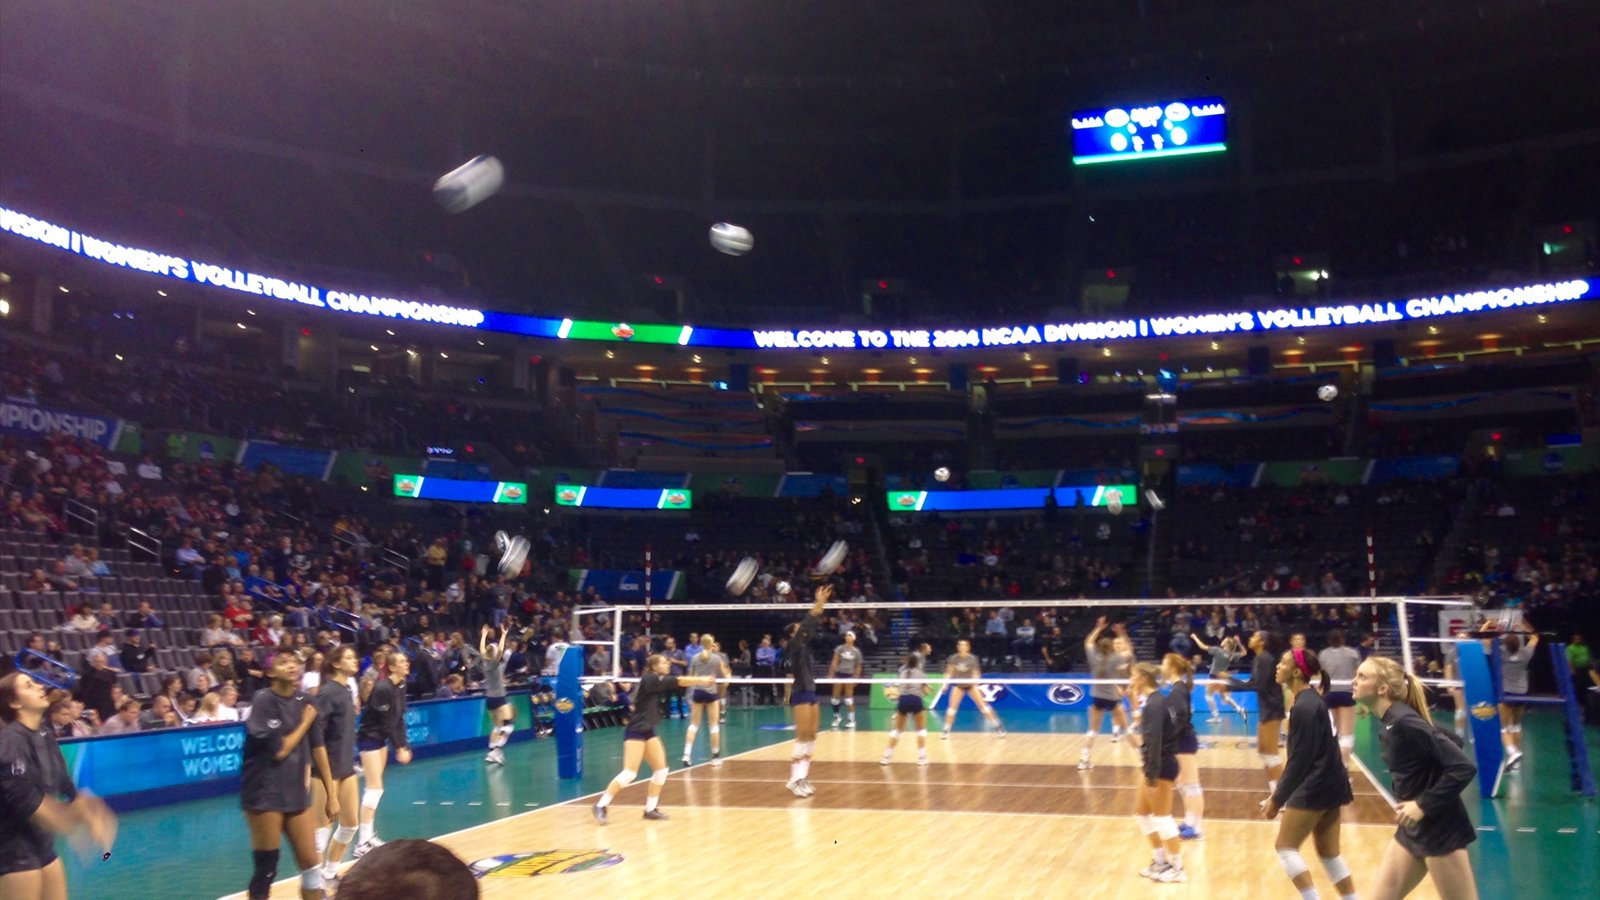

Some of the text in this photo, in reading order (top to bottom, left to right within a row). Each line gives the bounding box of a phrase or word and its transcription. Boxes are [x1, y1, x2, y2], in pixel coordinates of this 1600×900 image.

[82, 234, 188, 278] WOMEN'S
[191, 261, 325, 307] VOLLEYBALL
[326, 291, 484, 327] CHAMPIONSHIP
[753, 280, 1590, 348] WELCOME TO THE 2014 NCAA DIVISION I WOMEN'S VOLLEYBALL CHAMPIONSHIP
